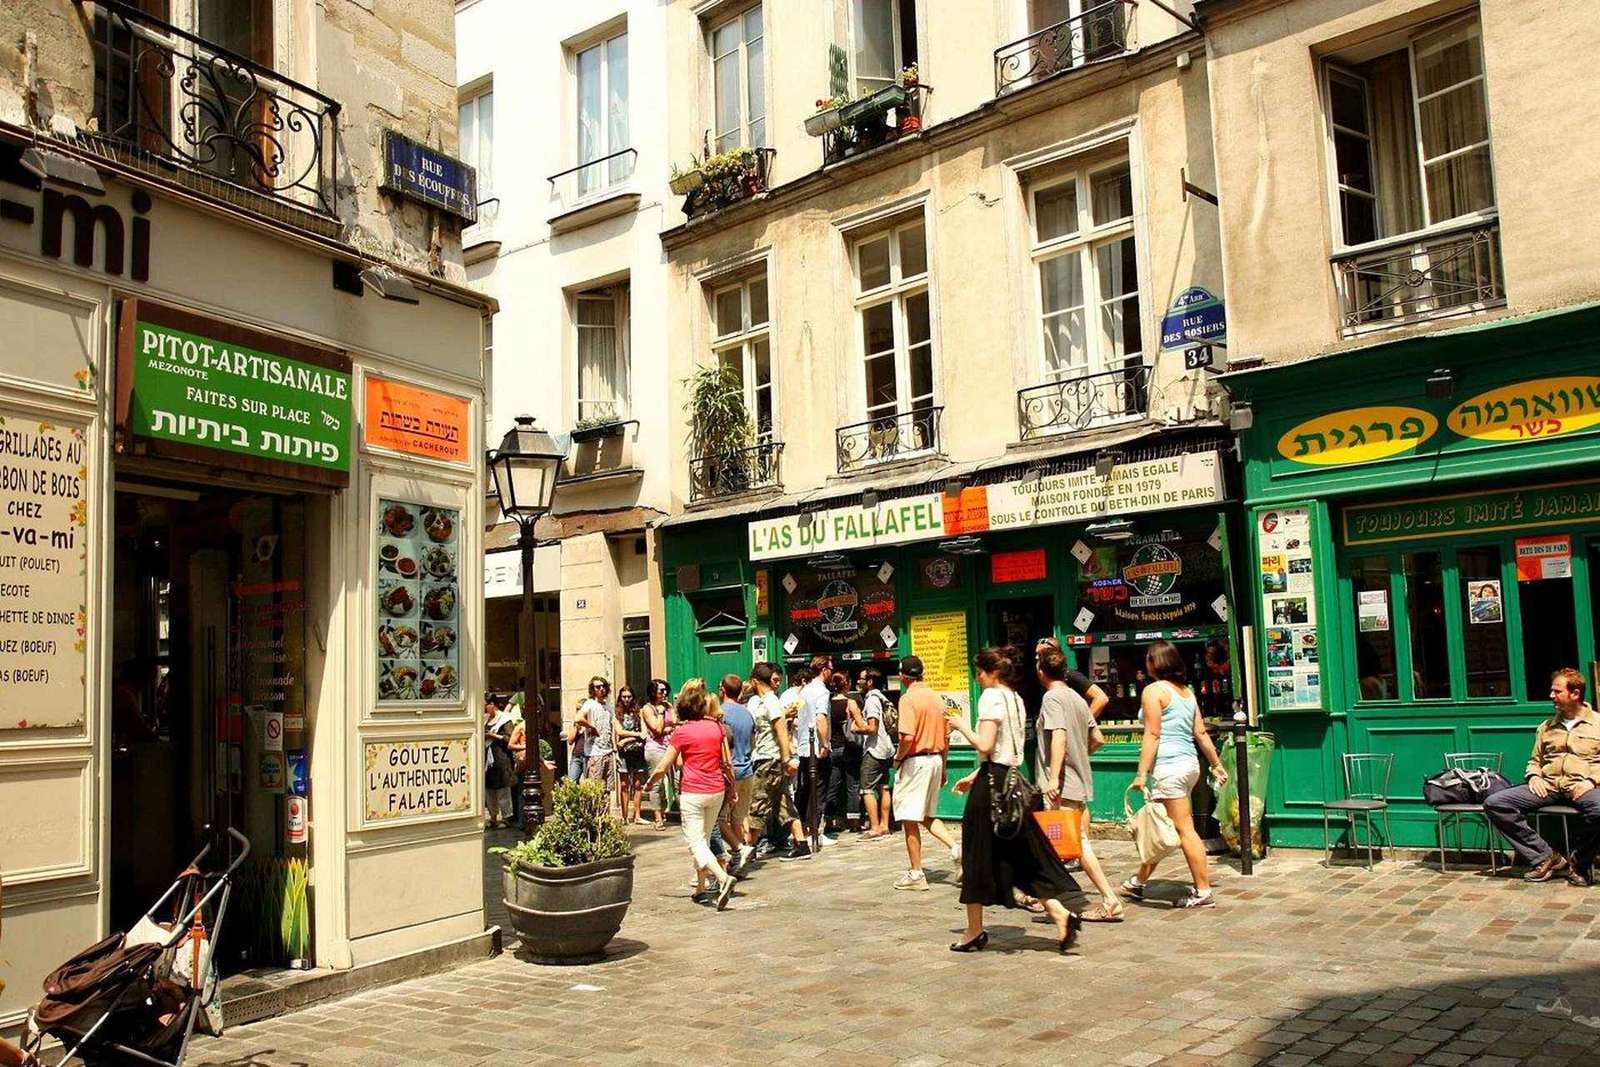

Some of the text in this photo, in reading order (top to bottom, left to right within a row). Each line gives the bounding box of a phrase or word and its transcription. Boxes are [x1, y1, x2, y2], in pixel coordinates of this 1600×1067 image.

[421, 157, 443, 177] RUE
[393, 163, 470, 205] DS ÉCOUFFS
[1182, 315, 1203, 328] RUE
[1163, 321, 1225, 344] DES ROSIERS
[142, 329, 348, 400] PITOT-ARTISANALE
[1188, 347, 1209, 367] 34
[148, 359, 209, 380] MEZONOTE
[186, 386, 311, 425] FAITES SUR PLACE
[321, 409, 340, 431] כשר
[380, 411, 420, 430] כשרות
[426, 420, 459, 440] תעודת
[1510, 418, 1562, 438] כשר
[151, 409, 340, 462] פיתות ביתיות
[1293, 416, 1425, 457] פרגית
[0, 430, 81, 464] GRILLADES AU
[412, 440, 459, 455] CACHEROUT
[0, 465, 79, 498] BON DE BOIS
[1012, 461, 1179, 495] TOUJOURS IMITE JAMAIS EGALE
[1031, 480, 1161, 506] MAISON FONDEE EN 1979
[8, 501, 42, 518] CHEZ
[991, 487, 1215, 526] SOUS LE CONTROLE DU BETH-DIN DE PARIS
[1356, 507, 1455, 534] TOUJOURS
[1464, 493, 1523, 523] IMITÉ
[752, 503, 941, 552] L'AS DU FALLAFEL
[20, 557, 60, 574] (POULET)
[1, 583, 30, 598] ECOTE
[1092, 578, 1122, 587] KOSHER
[32, 611, 43, 624] DE
[47, 612, 75, 625] DINDE
[21, 640, 56, 655] (BOEUF)
[13, 669, 49, 684] (BOEUF)
[389, 746, 449, 766] GOUTEZ
[370, 766, 466, 790] L'AUTHENTIQUE
[388, 789, 451, 811] FALAFEL
